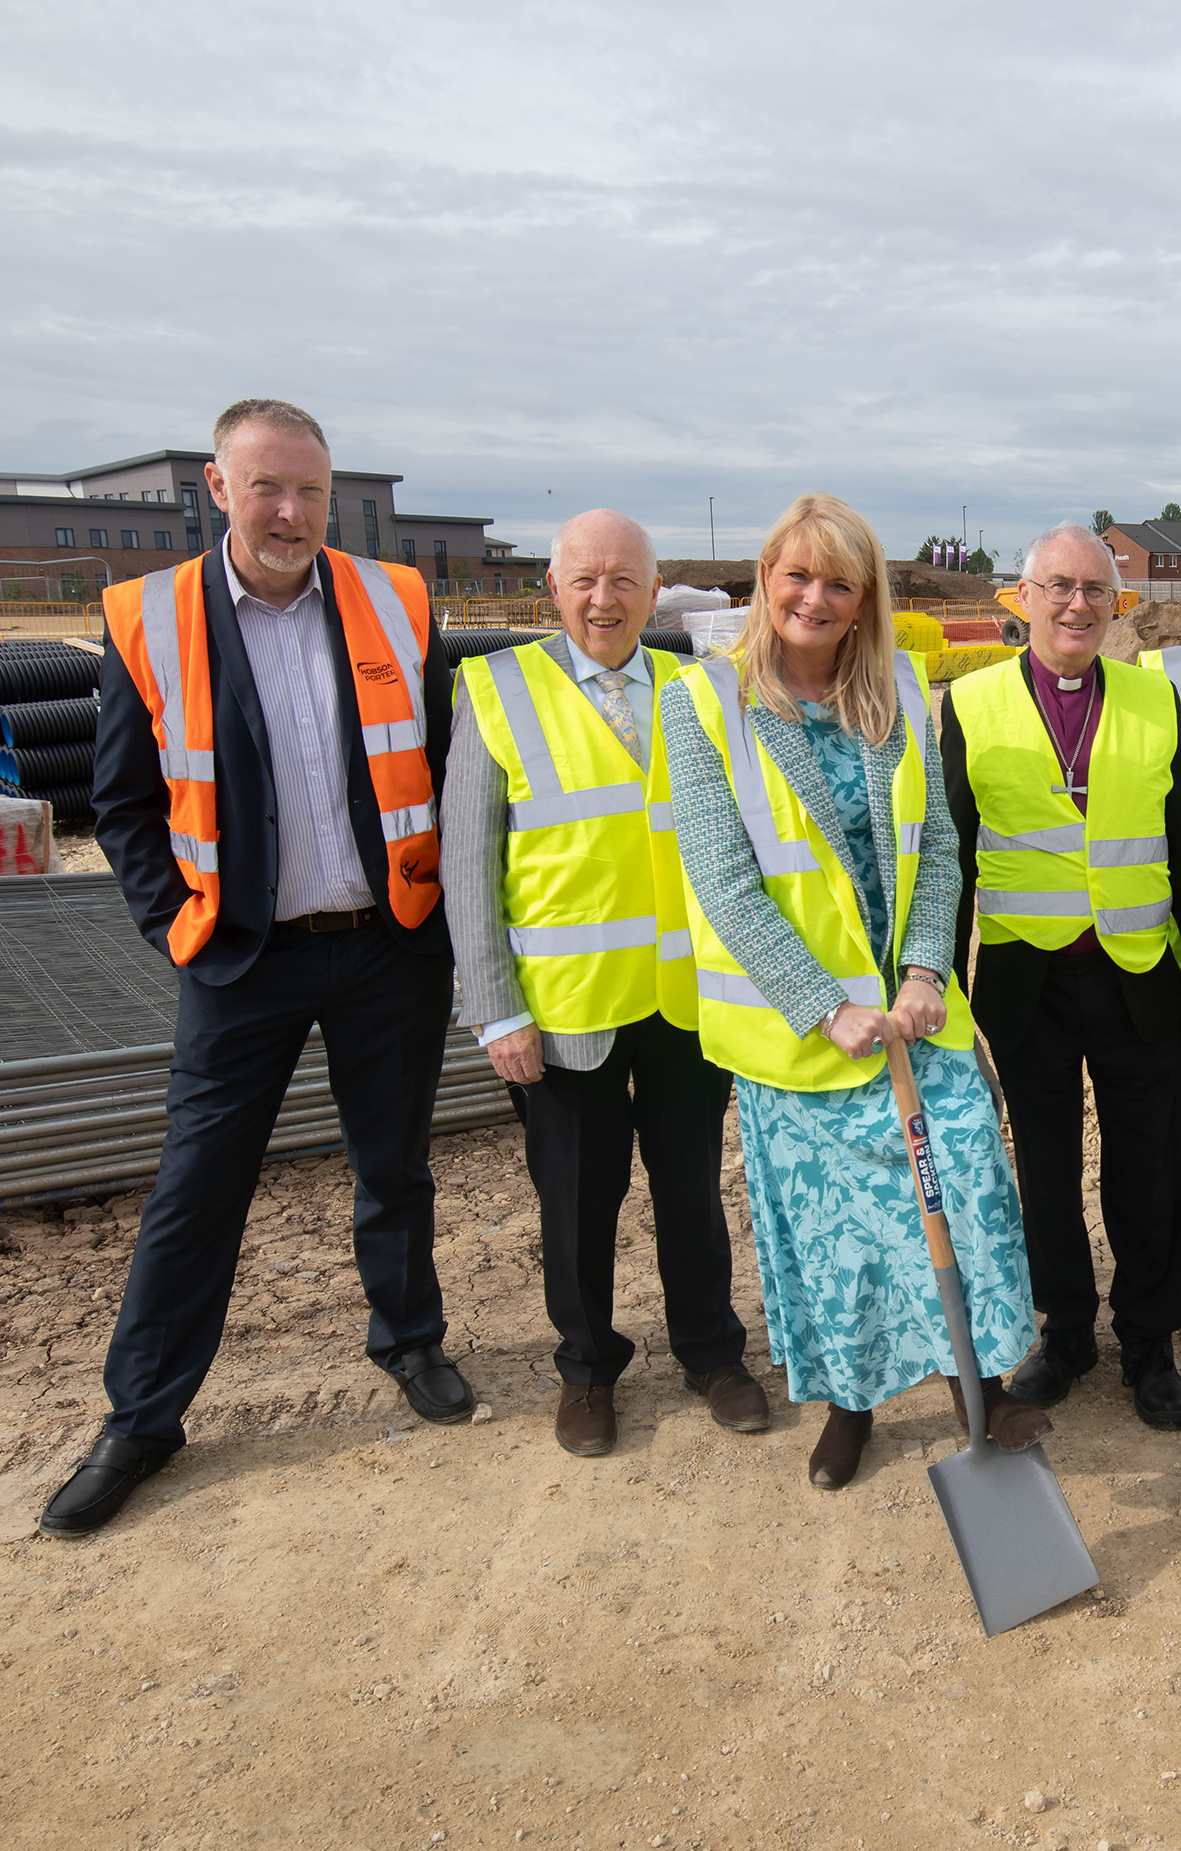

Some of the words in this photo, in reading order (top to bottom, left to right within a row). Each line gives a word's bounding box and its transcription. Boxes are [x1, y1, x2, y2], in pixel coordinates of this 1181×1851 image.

[361, 663, 393, 675] HOBSON
[365, 670, 396, 682] PORTER
[916, 1147, 925, 1156] &
[925, 1144, 941, 1197] JACKSON
[919, 1159, 935, 1198] SPEAR
